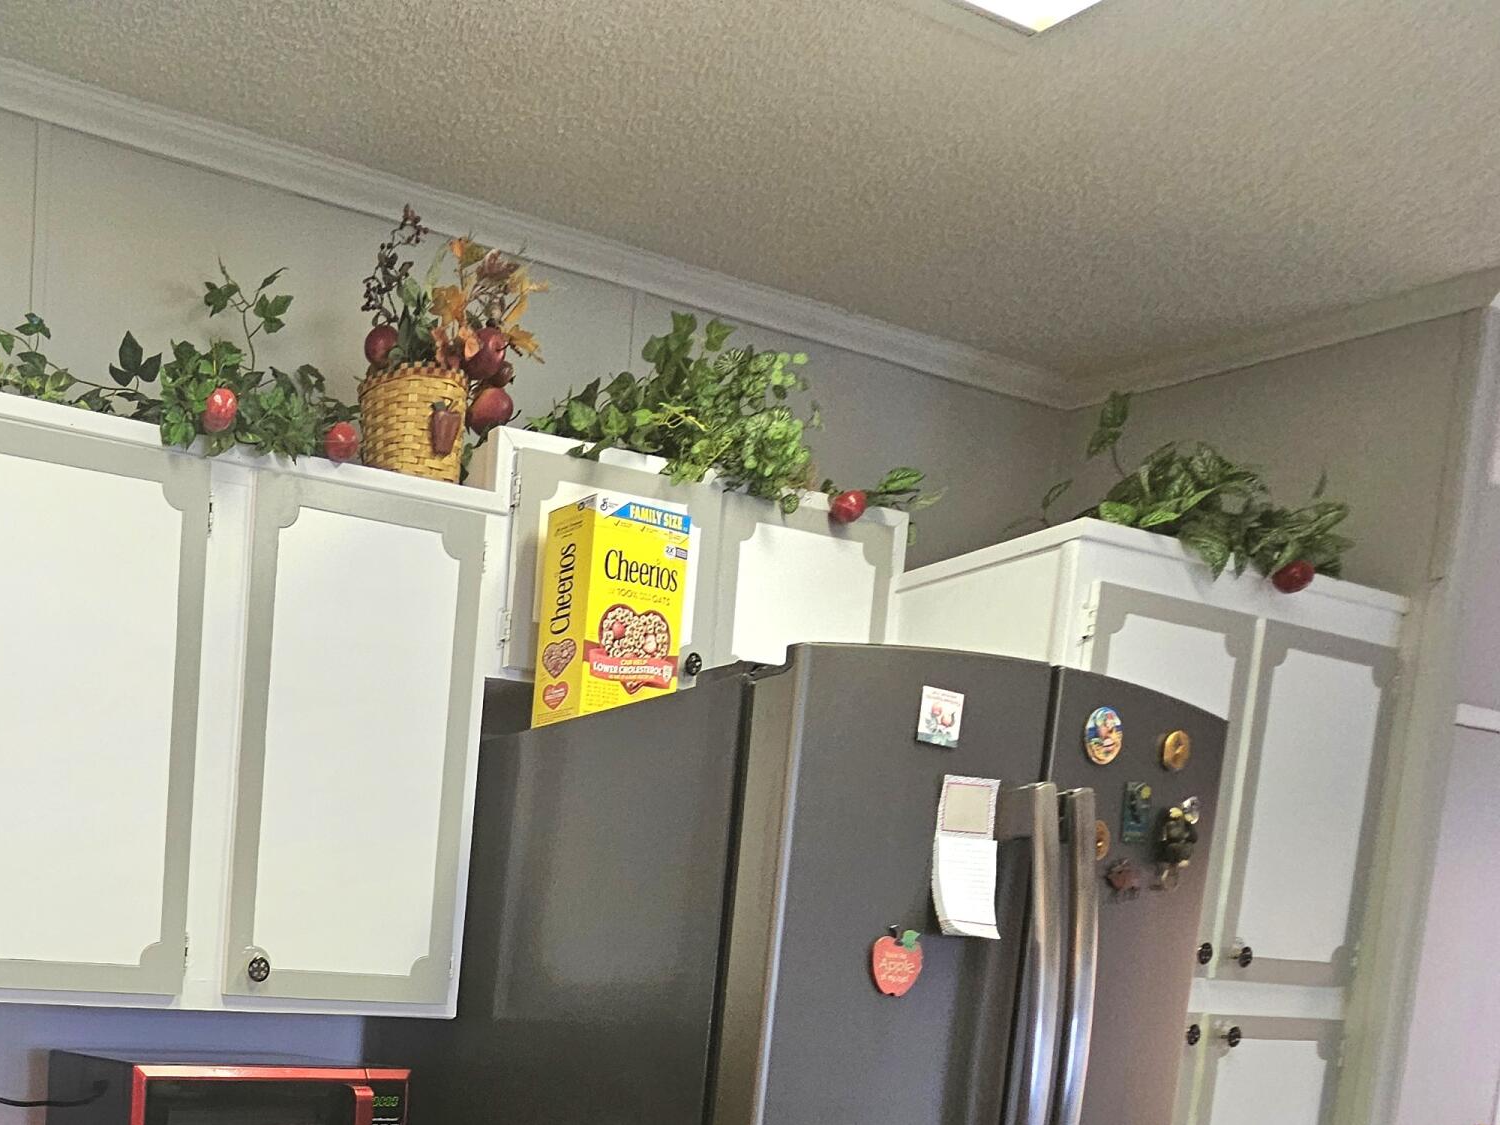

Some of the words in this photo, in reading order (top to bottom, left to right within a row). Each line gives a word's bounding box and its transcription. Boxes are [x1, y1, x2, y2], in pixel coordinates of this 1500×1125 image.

[630, 504, 662, 527] FAMILY
[663, 512, 683, 531] SIZE
[550, 543, 576, 635] Cheerios
[604, 549, 678, 592] Cheerios
